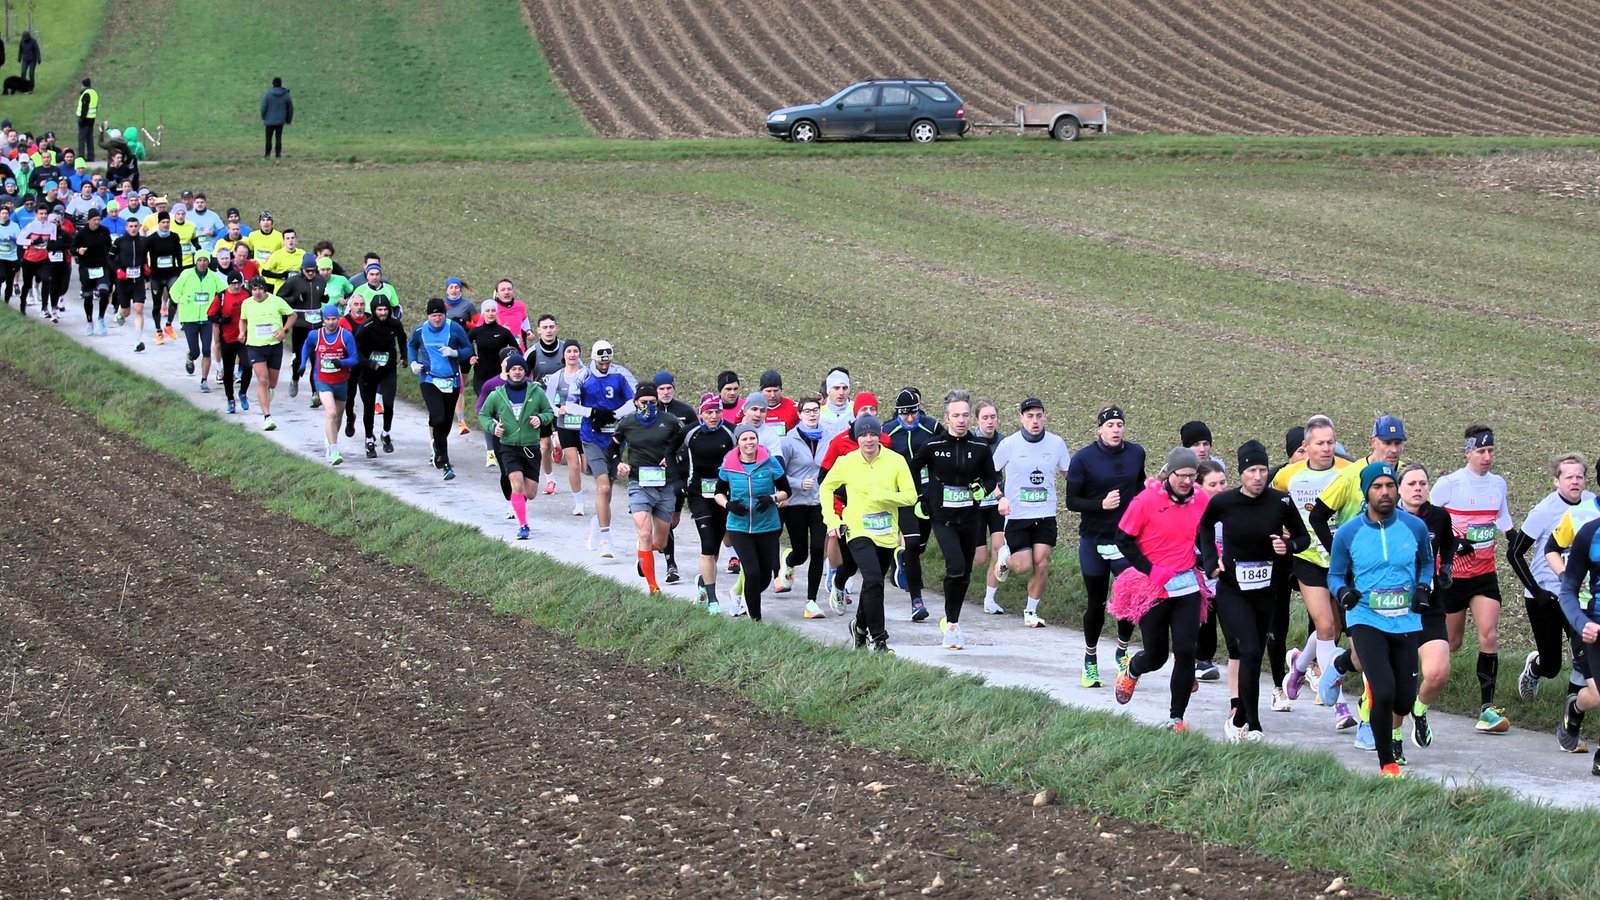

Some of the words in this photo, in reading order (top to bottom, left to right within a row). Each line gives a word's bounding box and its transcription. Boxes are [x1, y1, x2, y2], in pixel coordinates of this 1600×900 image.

[605, 386, 614, 398] 3
[1024, 492, 1045, 500] 1494
[868, 516, 888, 528] 1381
[1472, 528, 1494, 540] 1496
[1242, 568, 1268, 580] 1848
[1376, 594, 1405, 606] 1440
